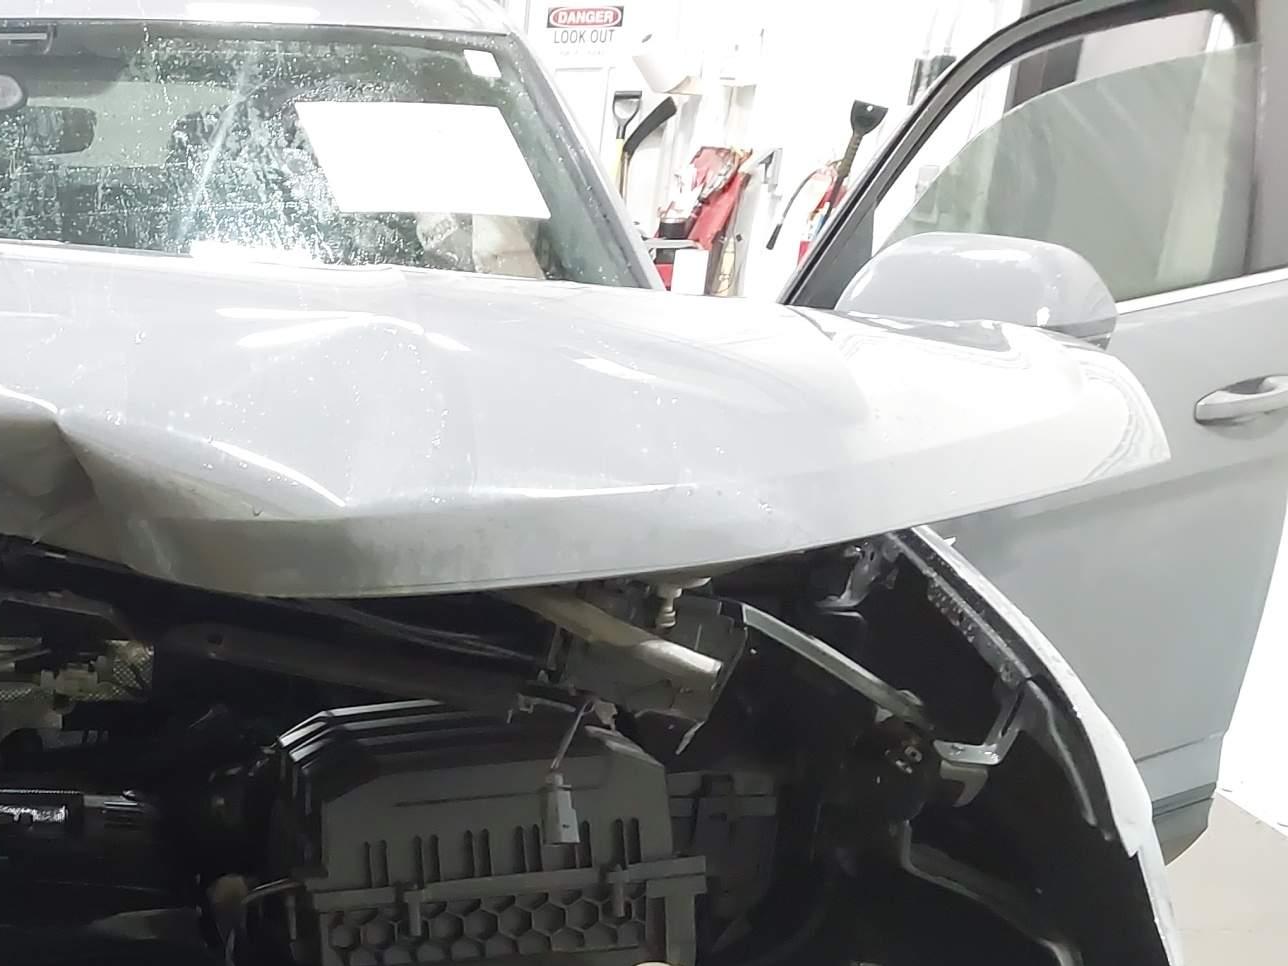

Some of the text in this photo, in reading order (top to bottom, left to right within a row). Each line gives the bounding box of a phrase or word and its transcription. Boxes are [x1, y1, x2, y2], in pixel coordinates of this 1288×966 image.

[557, 10, 614, 24] DANGER
[553, 29, 615, 44] LOOK OUT
